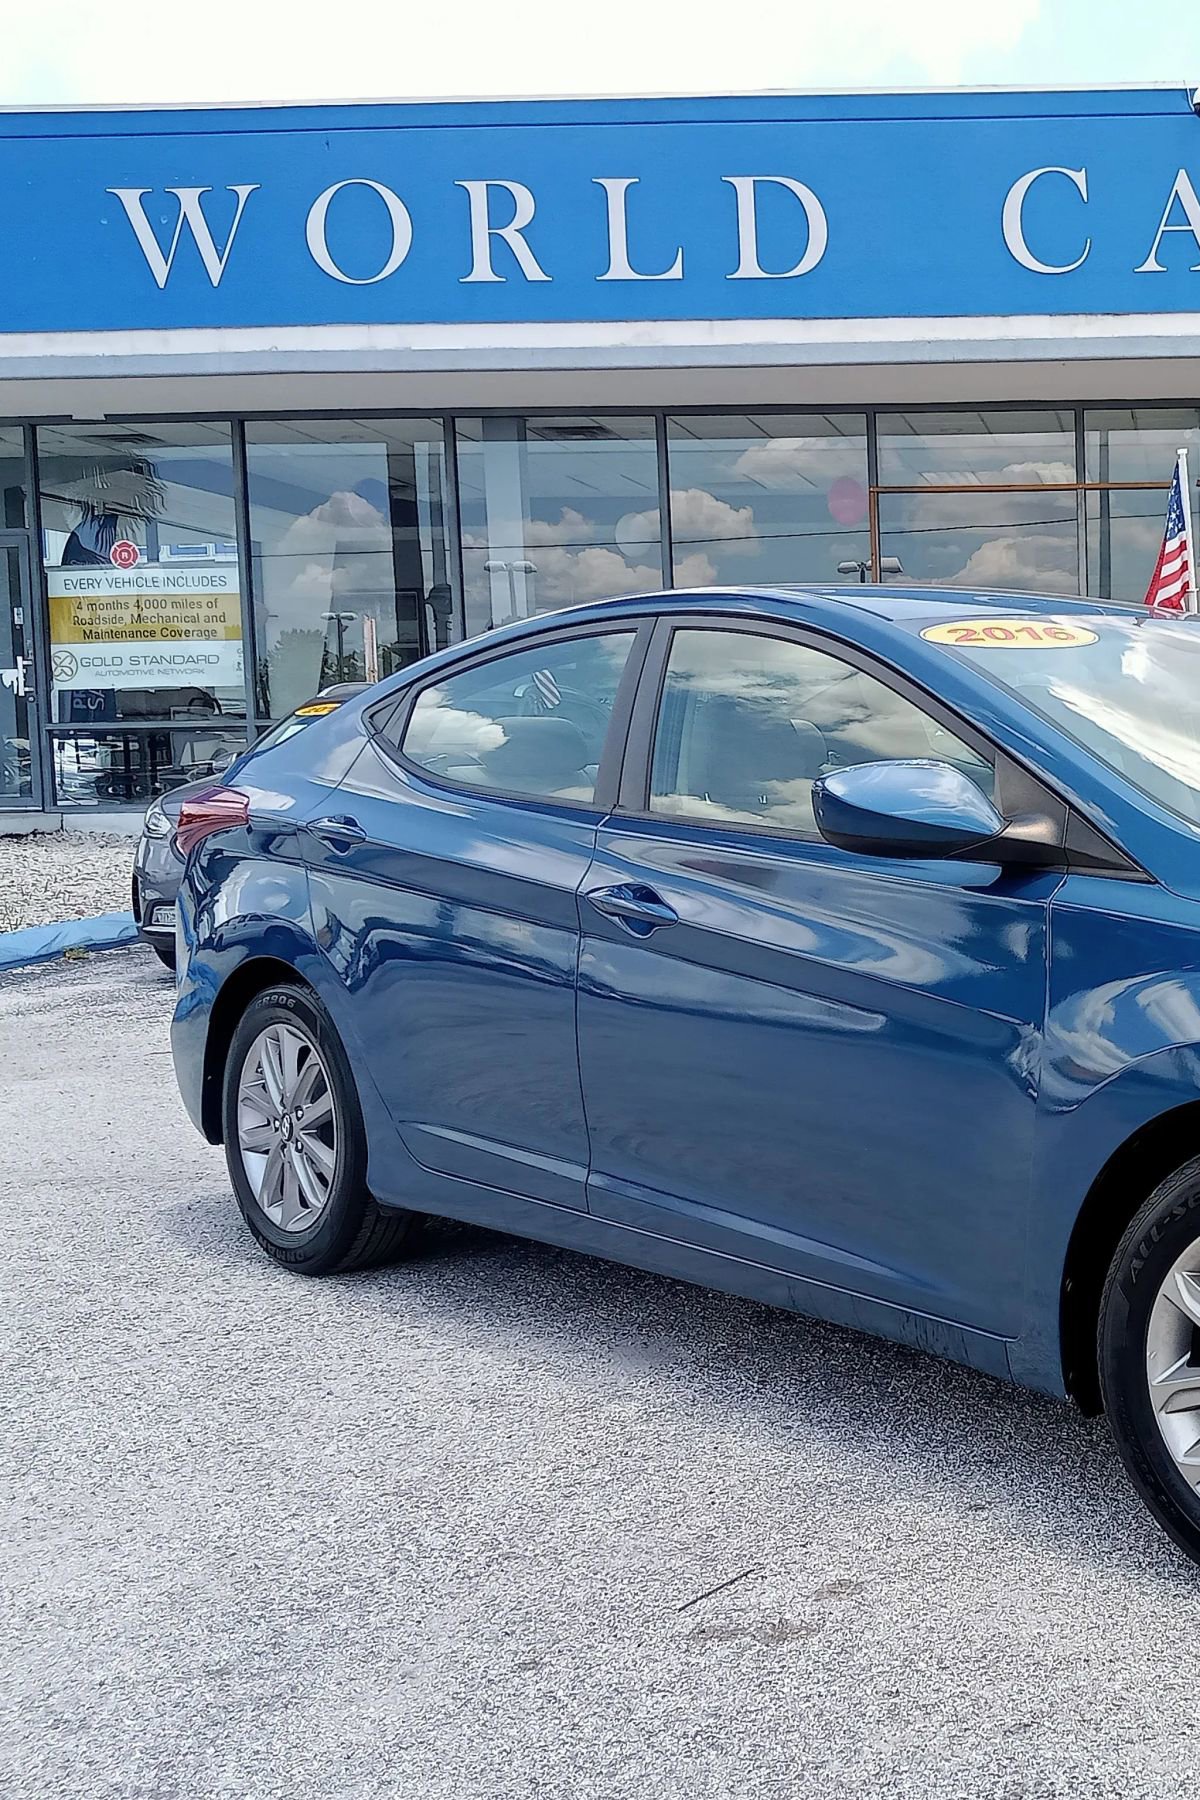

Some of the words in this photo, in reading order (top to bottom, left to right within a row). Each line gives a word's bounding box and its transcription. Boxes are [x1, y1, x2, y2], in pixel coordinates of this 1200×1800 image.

[105, 174, 829, 290] WORLD
[64, 577, 102, 590] EVERY
[105, 576, 159, 589] VEHICLE
[163, 575, 227, 588] INCLUDES
[76, 602, 83, 610] 4
[87, 600, 130, 611] months
[133, 599, 167, 611] 4,000
[171, 599, 202, 609] miles
[206, 598, 219, 609] of
[73, 613, 127, 626] Roadside,
[130, 612, 200, 625] Mechanical
[204, 612, 226, 623] and
[83, 627, 156, 640] Maintenance
[160, 627, 218, 640] Coverage
[947, 626, 1077, 642] 2016
[80, 656, 123, 667] GOLD
[129, 654, 220, 666] STANDARD
[95, 669, 155, 677] AUTOMOTIVE
